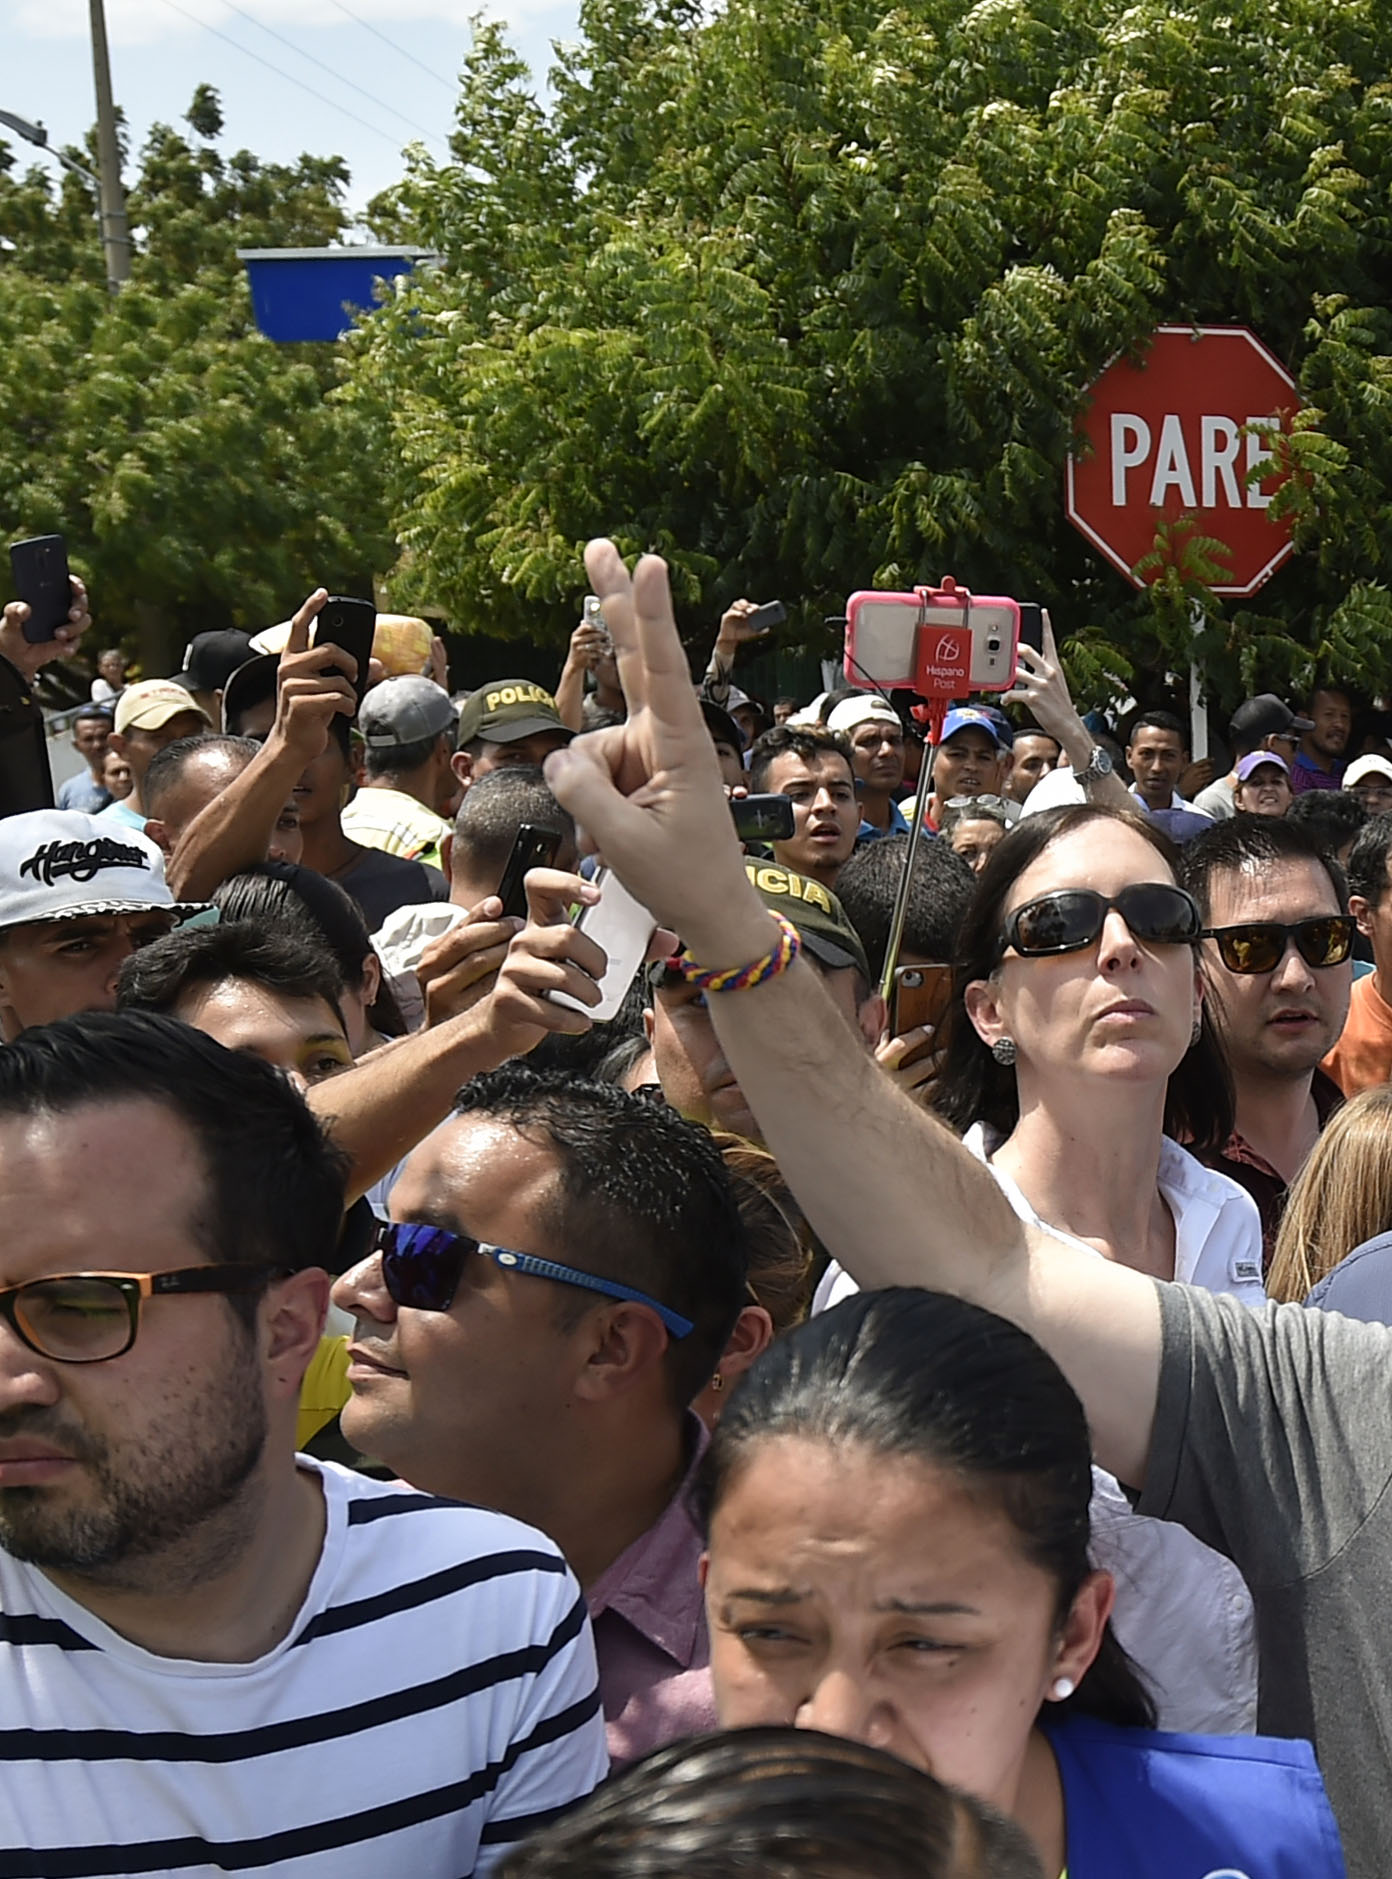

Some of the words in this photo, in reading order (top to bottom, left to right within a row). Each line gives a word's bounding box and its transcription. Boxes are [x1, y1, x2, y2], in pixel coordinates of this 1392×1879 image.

[1111, 413, 1280, 508] PARE
[926, 665, 965, 678] Hispano
[934, 678, 956, 689] Post
